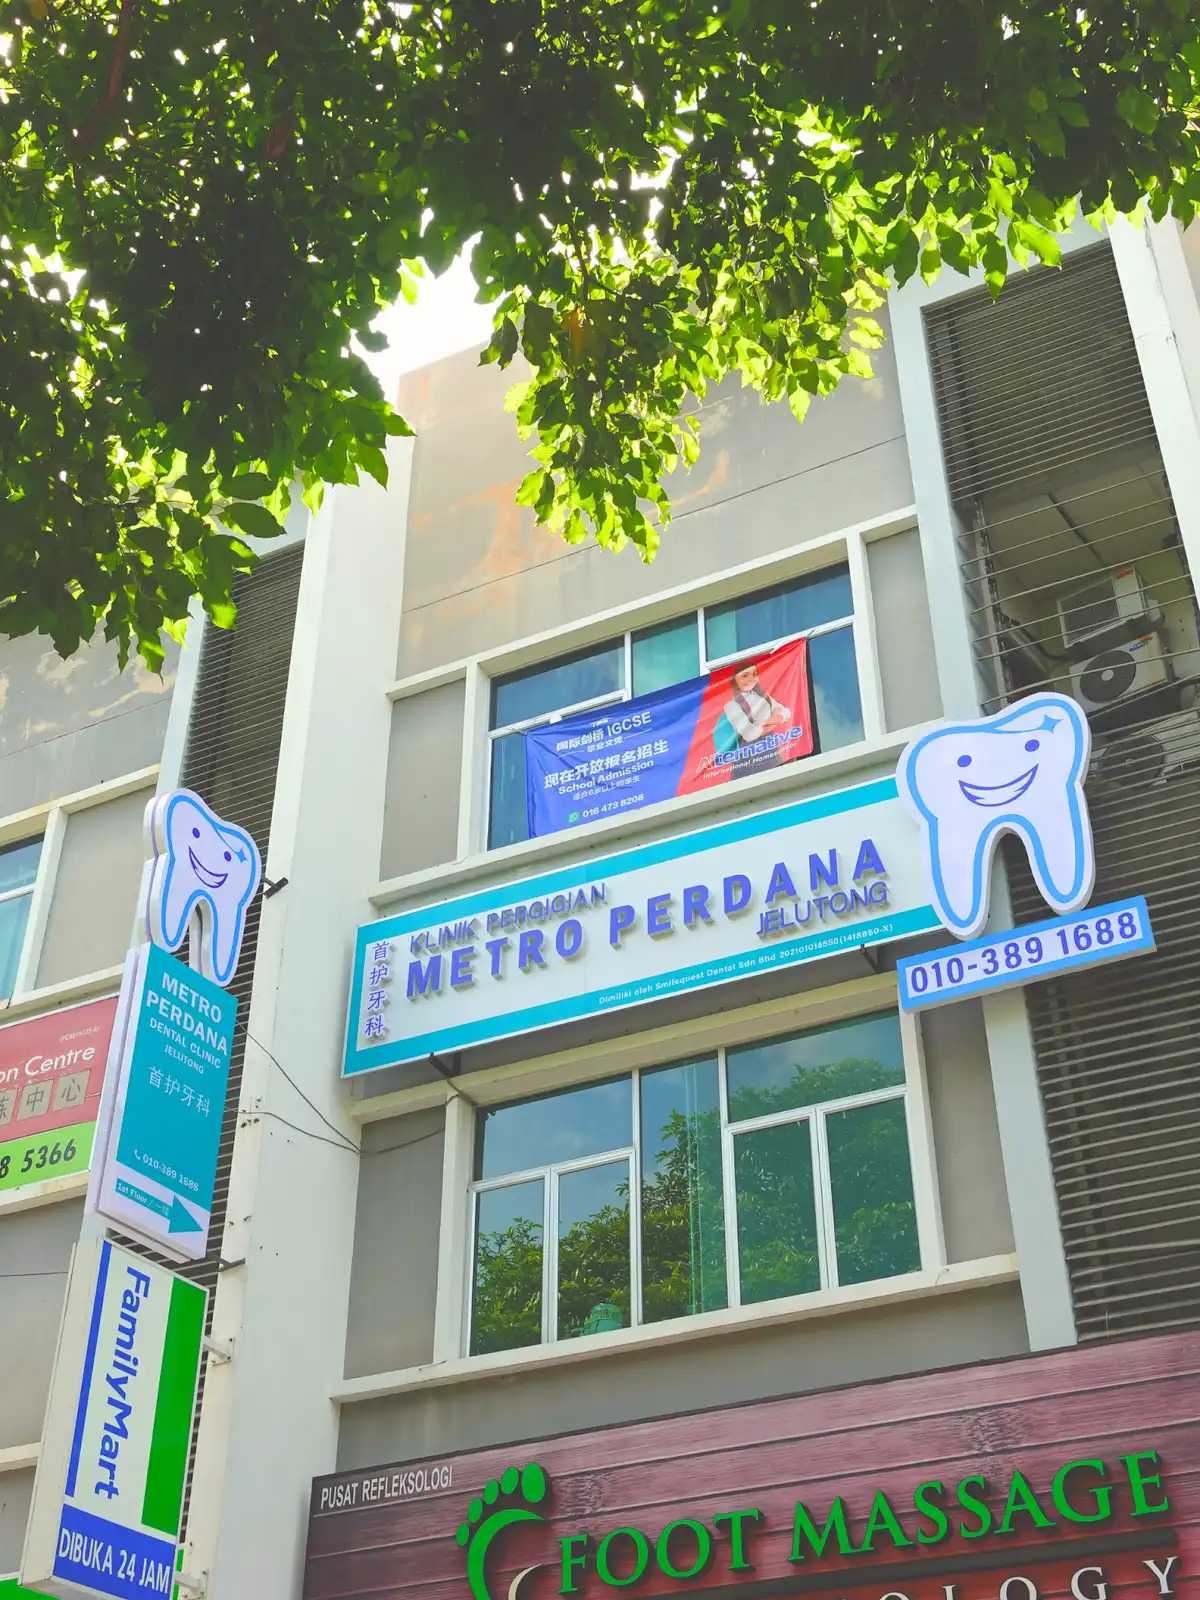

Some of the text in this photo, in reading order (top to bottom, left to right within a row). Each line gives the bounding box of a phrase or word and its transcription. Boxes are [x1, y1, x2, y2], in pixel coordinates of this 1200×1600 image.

[607, 711, 652, 737] IGCSE
[695, 725, 802, 774] Alternative
[544, 739, 669, 789] 现在开放报名招生
[558, 760, 654, 795] School Admission
[703, 758, 751, 780] International
[582, 793, 645, 818] 016 473 8208
[406, 838, 887, 999] METRO PERDANA
[410, 883, 606, 953] KLINIK PERGIGIAN
[756, 881, 889, 937] JELUTONG
[911, 911, 1137, 993] 010-389 1688
[162, 972, 222, 1023] METRO
[364, 941, 391, 1037] 首护牙科
[599, 988, 632, 1004] Dimiliki
[634, 984, 653, 996] oleh
[655, 970, 705, 991] Smilequest
[706, 962, 737, 978] Dental
[738, 957, 756, 970] Sdn
[758, 952, 777, 965] Bhd
[146, 990, 228, 1056] PERDANA
[150, 1017, 221, 1069] DENTAL CLINIC
[25, 1046, 96, 1077] Centre
[164, 1045, 205, 1075] JELUTONG
[149, 1065, 211, 1118] 首护牙科
[21, 1138, 77, 1173] 5366
[142, 1153, 177, 1179] 010-389
[117, 1182, 129, 1194] 1st
[130, 1189, 148, 1204] Floor
[94, 1266, 151, 1500] FamilyMart
[320, 1465, 453, 1509] PUSAT REFLEKSOLOGI
[557, 1450, 1169, 1594] FOOT MASSAGE
[58, 1527, 171, 1594] DIBUKA 24 JAM
